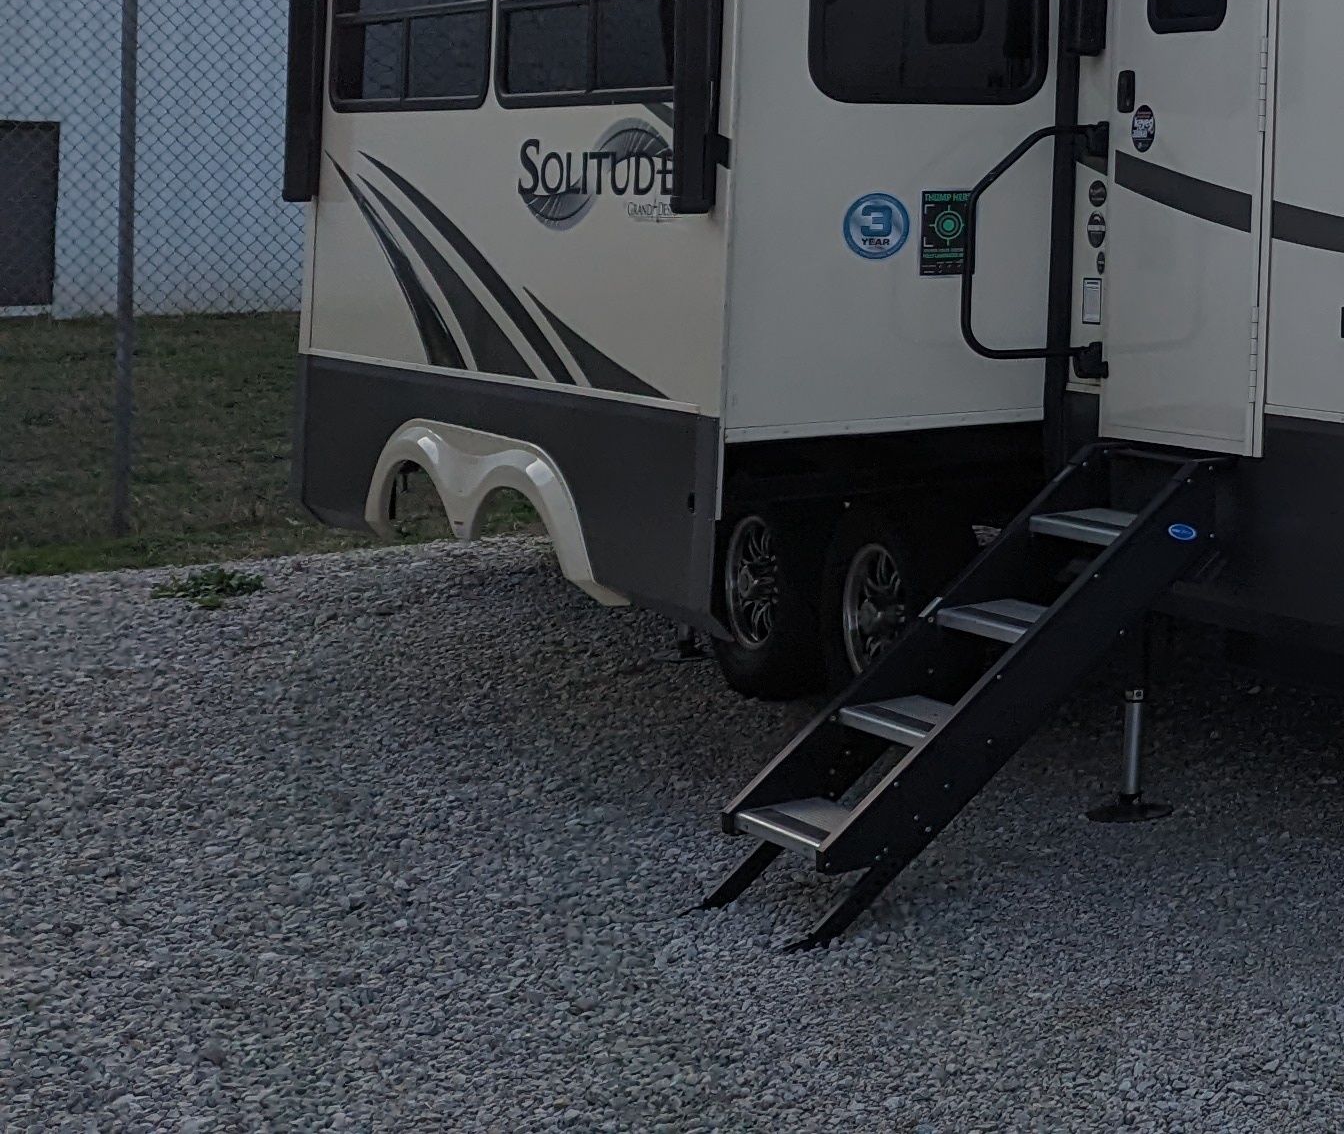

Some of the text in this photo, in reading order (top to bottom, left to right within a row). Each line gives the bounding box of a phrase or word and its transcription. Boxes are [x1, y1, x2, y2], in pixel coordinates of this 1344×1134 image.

[517, 138, 673, 196] SOLITUDE
[861, 205, 893, 237] 3
[861, 238, 890, 246] YEAR
